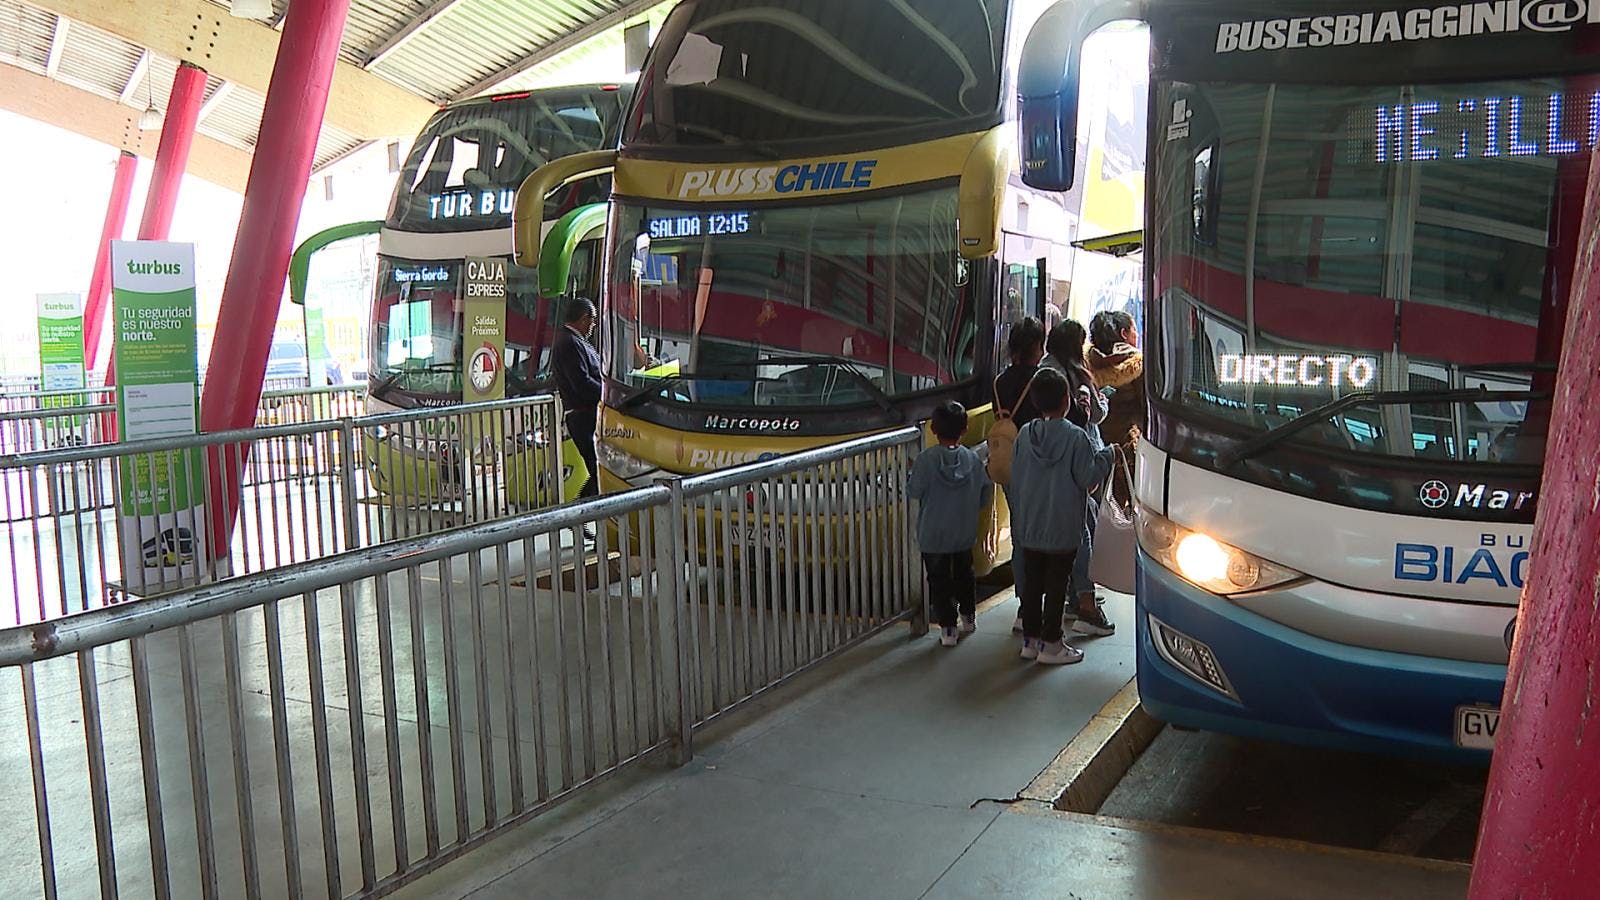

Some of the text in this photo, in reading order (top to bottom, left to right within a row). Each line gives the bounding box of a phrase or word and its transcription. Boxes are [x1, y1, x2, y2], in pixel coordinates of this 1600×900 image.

[429, 192, 473, 219] TUR
[650, 213, 750, 238] SALIDA 12:15
[126, 259, 181, 275] turbus
[395, 266, 449, 282] Sierra Gorda
[467, 262, 505, 281] CAJA
[467, 283, 505, 297] EXPRESS
[44, 302, 75, 311] turbus
[121, 306, 192, 321] Tu seguridad
[122, 318, 182, 331] es nuestro
[475, 315, 496, 326] Salidas
[122, 329, 157, 342] norte.
[1219, 353, 1376, 387] DIRECTO
[705, 414, 800, 431] Marcopolo
[1453, 483, 1533, 510] Mar
[1480, 533, 1524, 548] BU
[1464, 712, 1500, 737] GV
